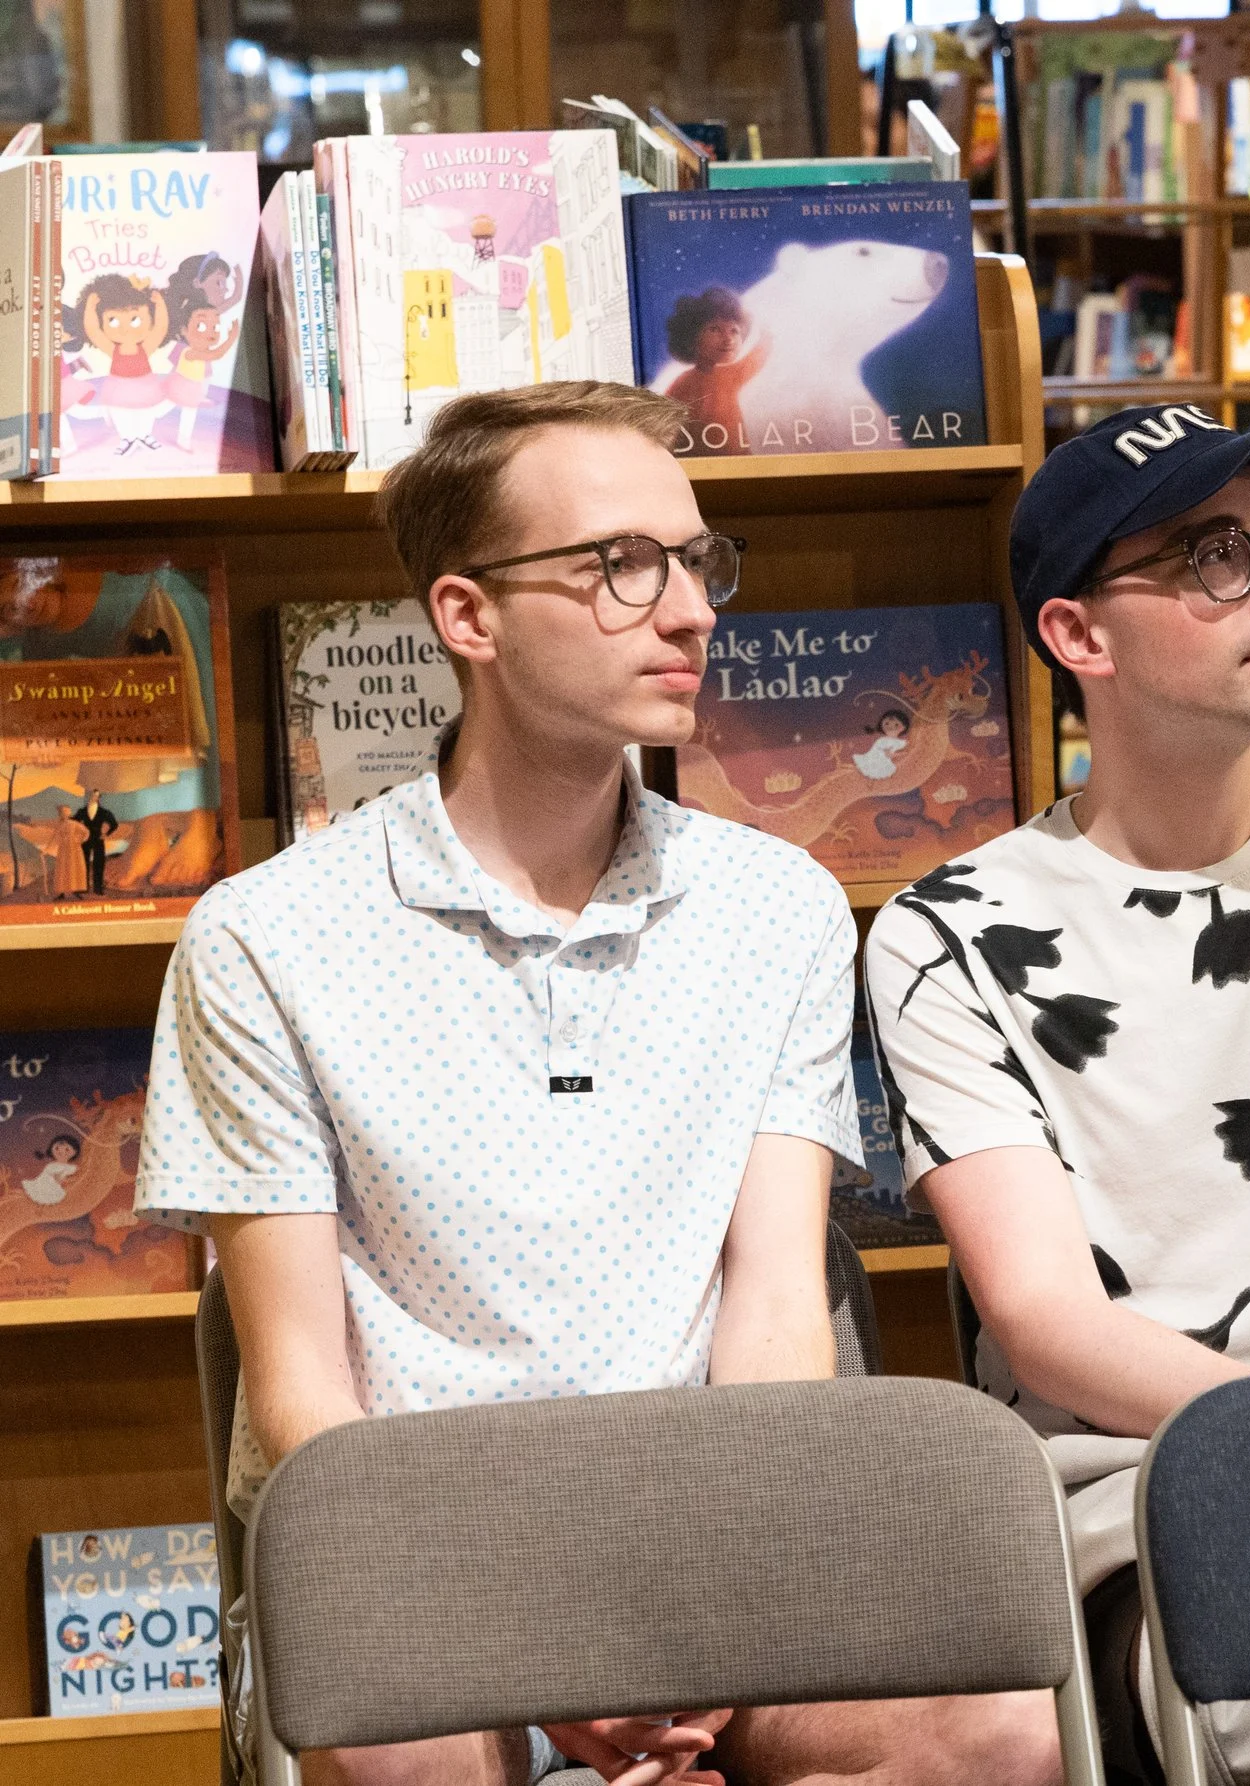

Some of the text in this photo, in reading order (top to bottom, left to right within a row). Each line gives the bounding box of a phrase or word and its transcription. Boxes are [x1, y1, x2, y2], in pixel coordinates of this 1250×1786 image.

[422, 146, 530, 171] HAROLD'S
[131, 168, 211, 218] RAY
[404, 171, 551, 201] HUNGRY EYES
[667, 206, 769, 222] BETH FERRY
[801, 202, 881, 217] BRENDAN
[886, 199, 955, 213] WENZEL
[84, 217, 149, 240] Tries
[68, 242, 167, 274] Ballet
[296, 268, 305, 287] You
[312, 268, 321, 287] You
[298, 290, 307, 319] Know
[313, 290, 322, 319] Know
[32, 321, 40, 357] BOOK
[53, 320, 62, 357] BOOK
[301, 323, 310, 350] What
[316, 322, 326, 350] What
[672, 404, 963, 453] SOLAR BEAR
[326, 635, 450, 668] noodles
[709, 627, 878, 665] ake Me to
[9, 675, 176, 705] Swamp Angel
[360, 674, 417, 696] on a
[332, 697, 446, 737] bicycle
[2, 1053, 50, 1078] to
[52, 1528, 217, 1566] HOW DO
[52, 1566, 219, 1601] YOU SAY
[56, 1605, 219, 1654] GOOD
